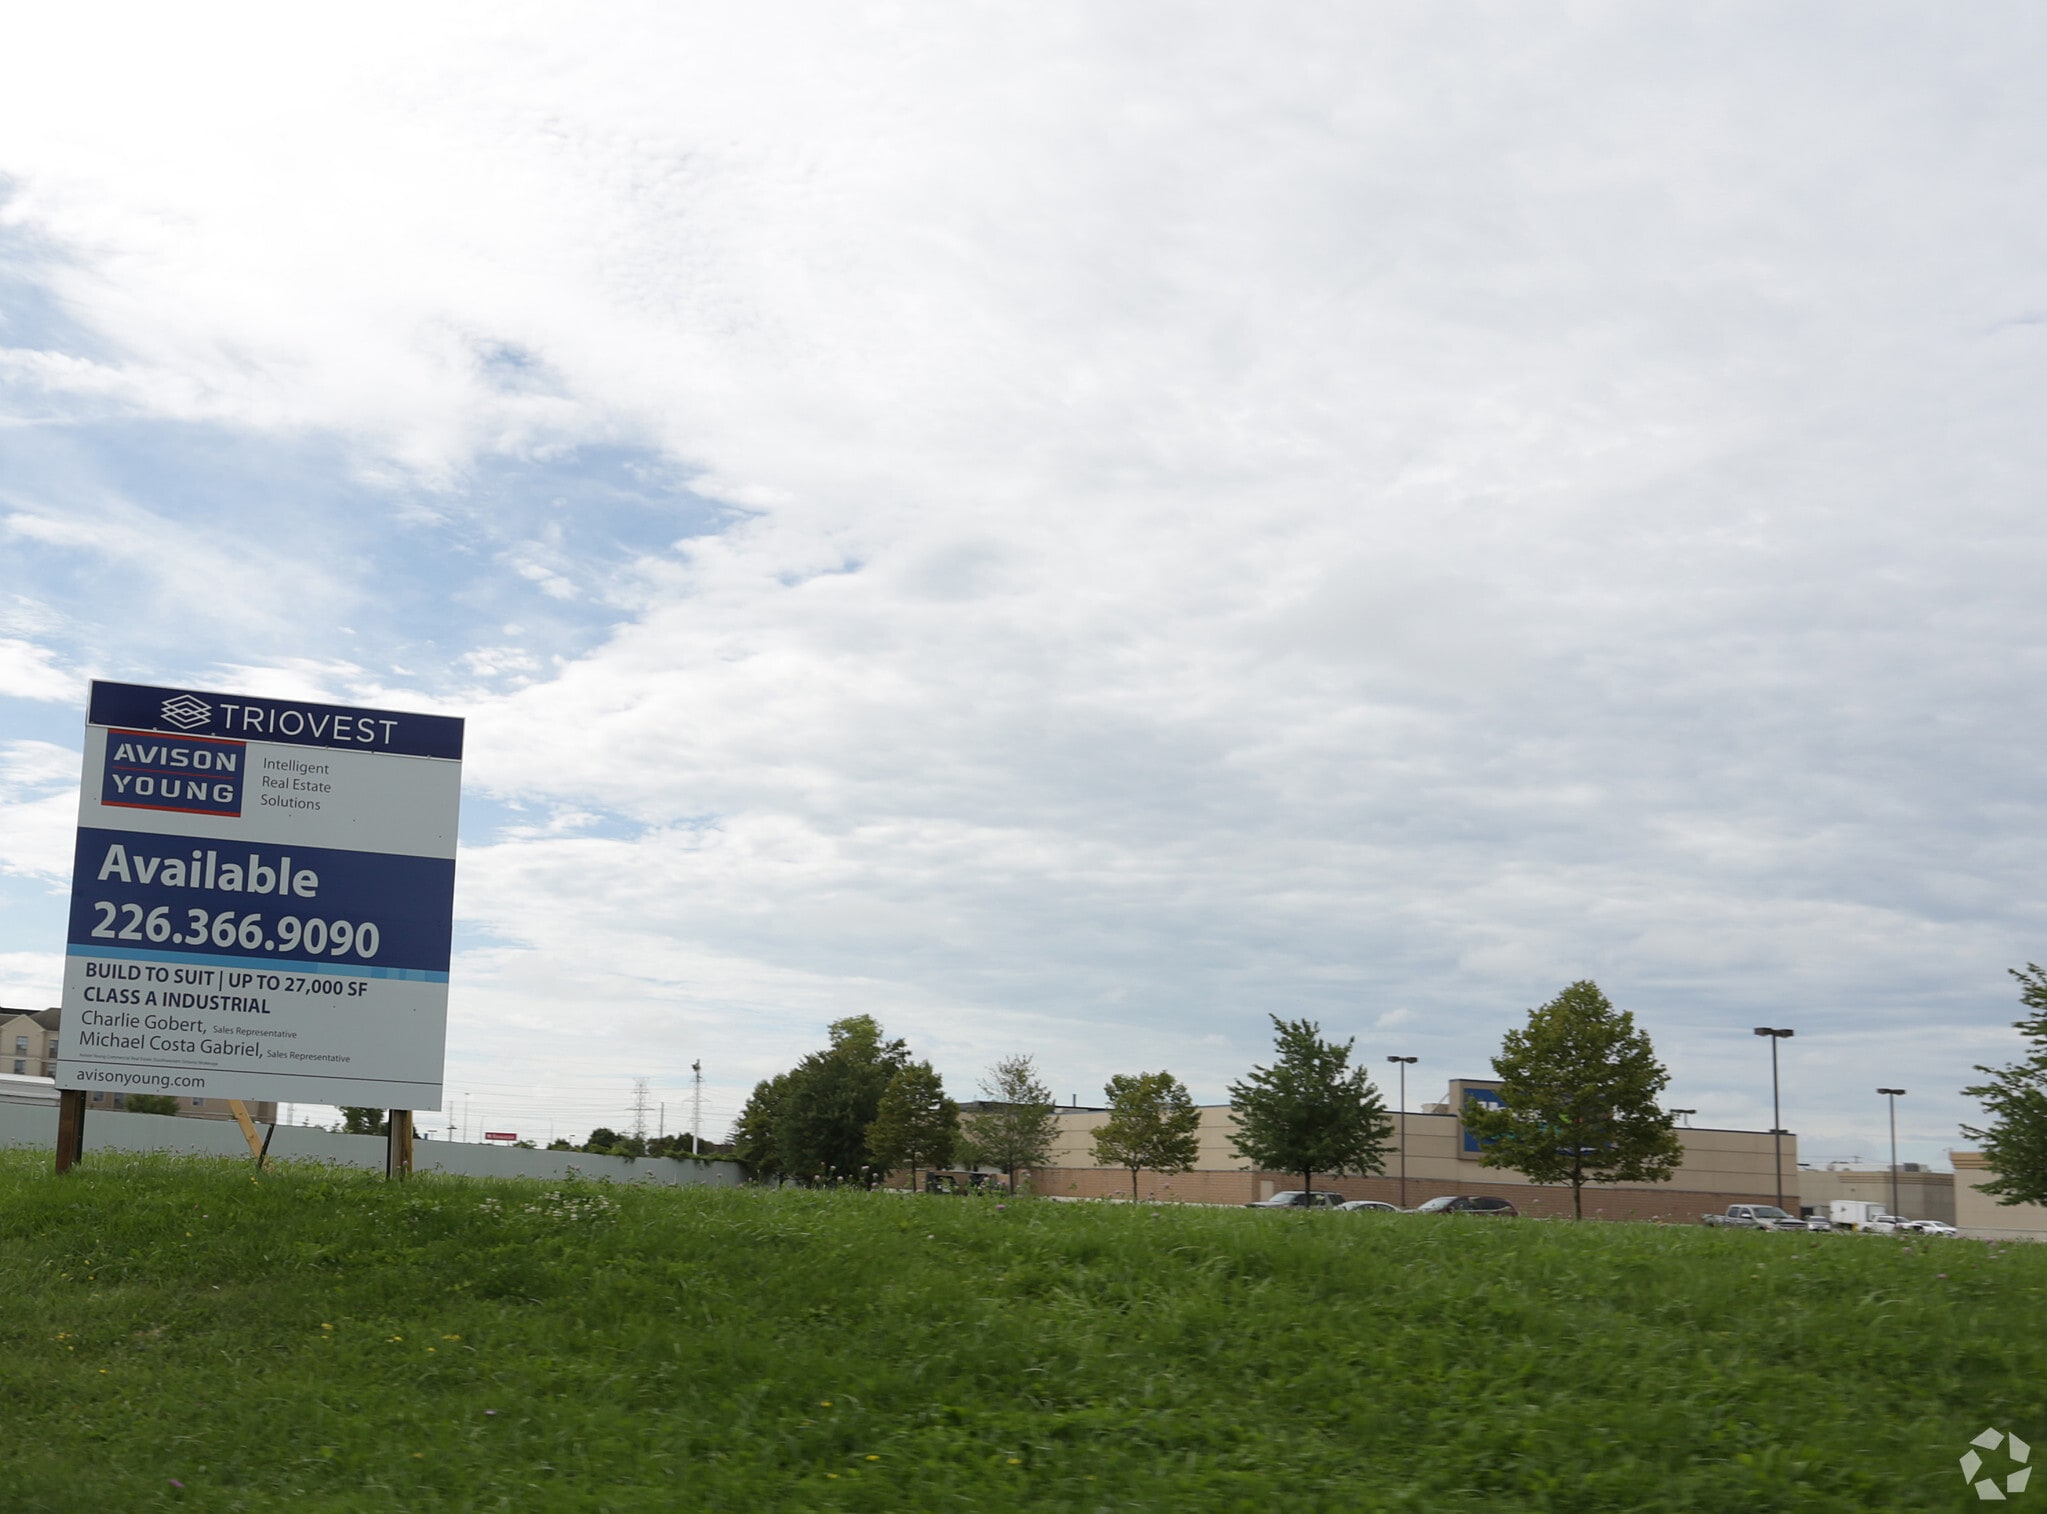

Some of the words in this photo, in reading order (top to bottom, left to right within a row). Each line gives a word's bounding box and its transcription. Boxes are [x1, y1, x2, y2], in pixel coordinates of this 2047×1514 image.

[220, 703, 398, 745] TRIOVEST
[113, 742, 237, 772] AVISON
[263, 758, 330, 776] Intelligent
[112, 774, 235, 803] YOUNG
[262, 776, 289, 790] Real
[293, 778, 332, 794] Estate
[260, 794, 322, 811] Solutions
[97, 844, 319, 898] Available
[91, 901, 380, 958] 226.366.9090
[86, 962, 141, 980] BUILD
[145, 966, 169, 983] TO
[174, 968, 215, 986] SUIT
[229, 973, 253, 988] UP
[257, 975, 280, 990] TO
[284, 977, 343, 996] 27,000
[347, 981, 368, 997] SF
[84, 986, 140, 1005] CLASS
[145, 990, 157, 1006] A
[162, 992, 271, 1014] INDUSTRIAL
[82, 1010, 140, 1028] Charlie
[144, 1014, 207, 1034] Gobert,
[213, 1025, 234, 1035] Sales
[236, 1027, 297, 1039] Representative
[79, 1031, 145, 1049] Michael
[149, 1035, 195, 1052] Costa
[200, 1038, 263, 1059] Gabriel,
[267, 1050, 288, 1059] Sales
[289, 1051, 351, 1063] Representative
[76, 1068, 205, 1089] avisonyoung.com
